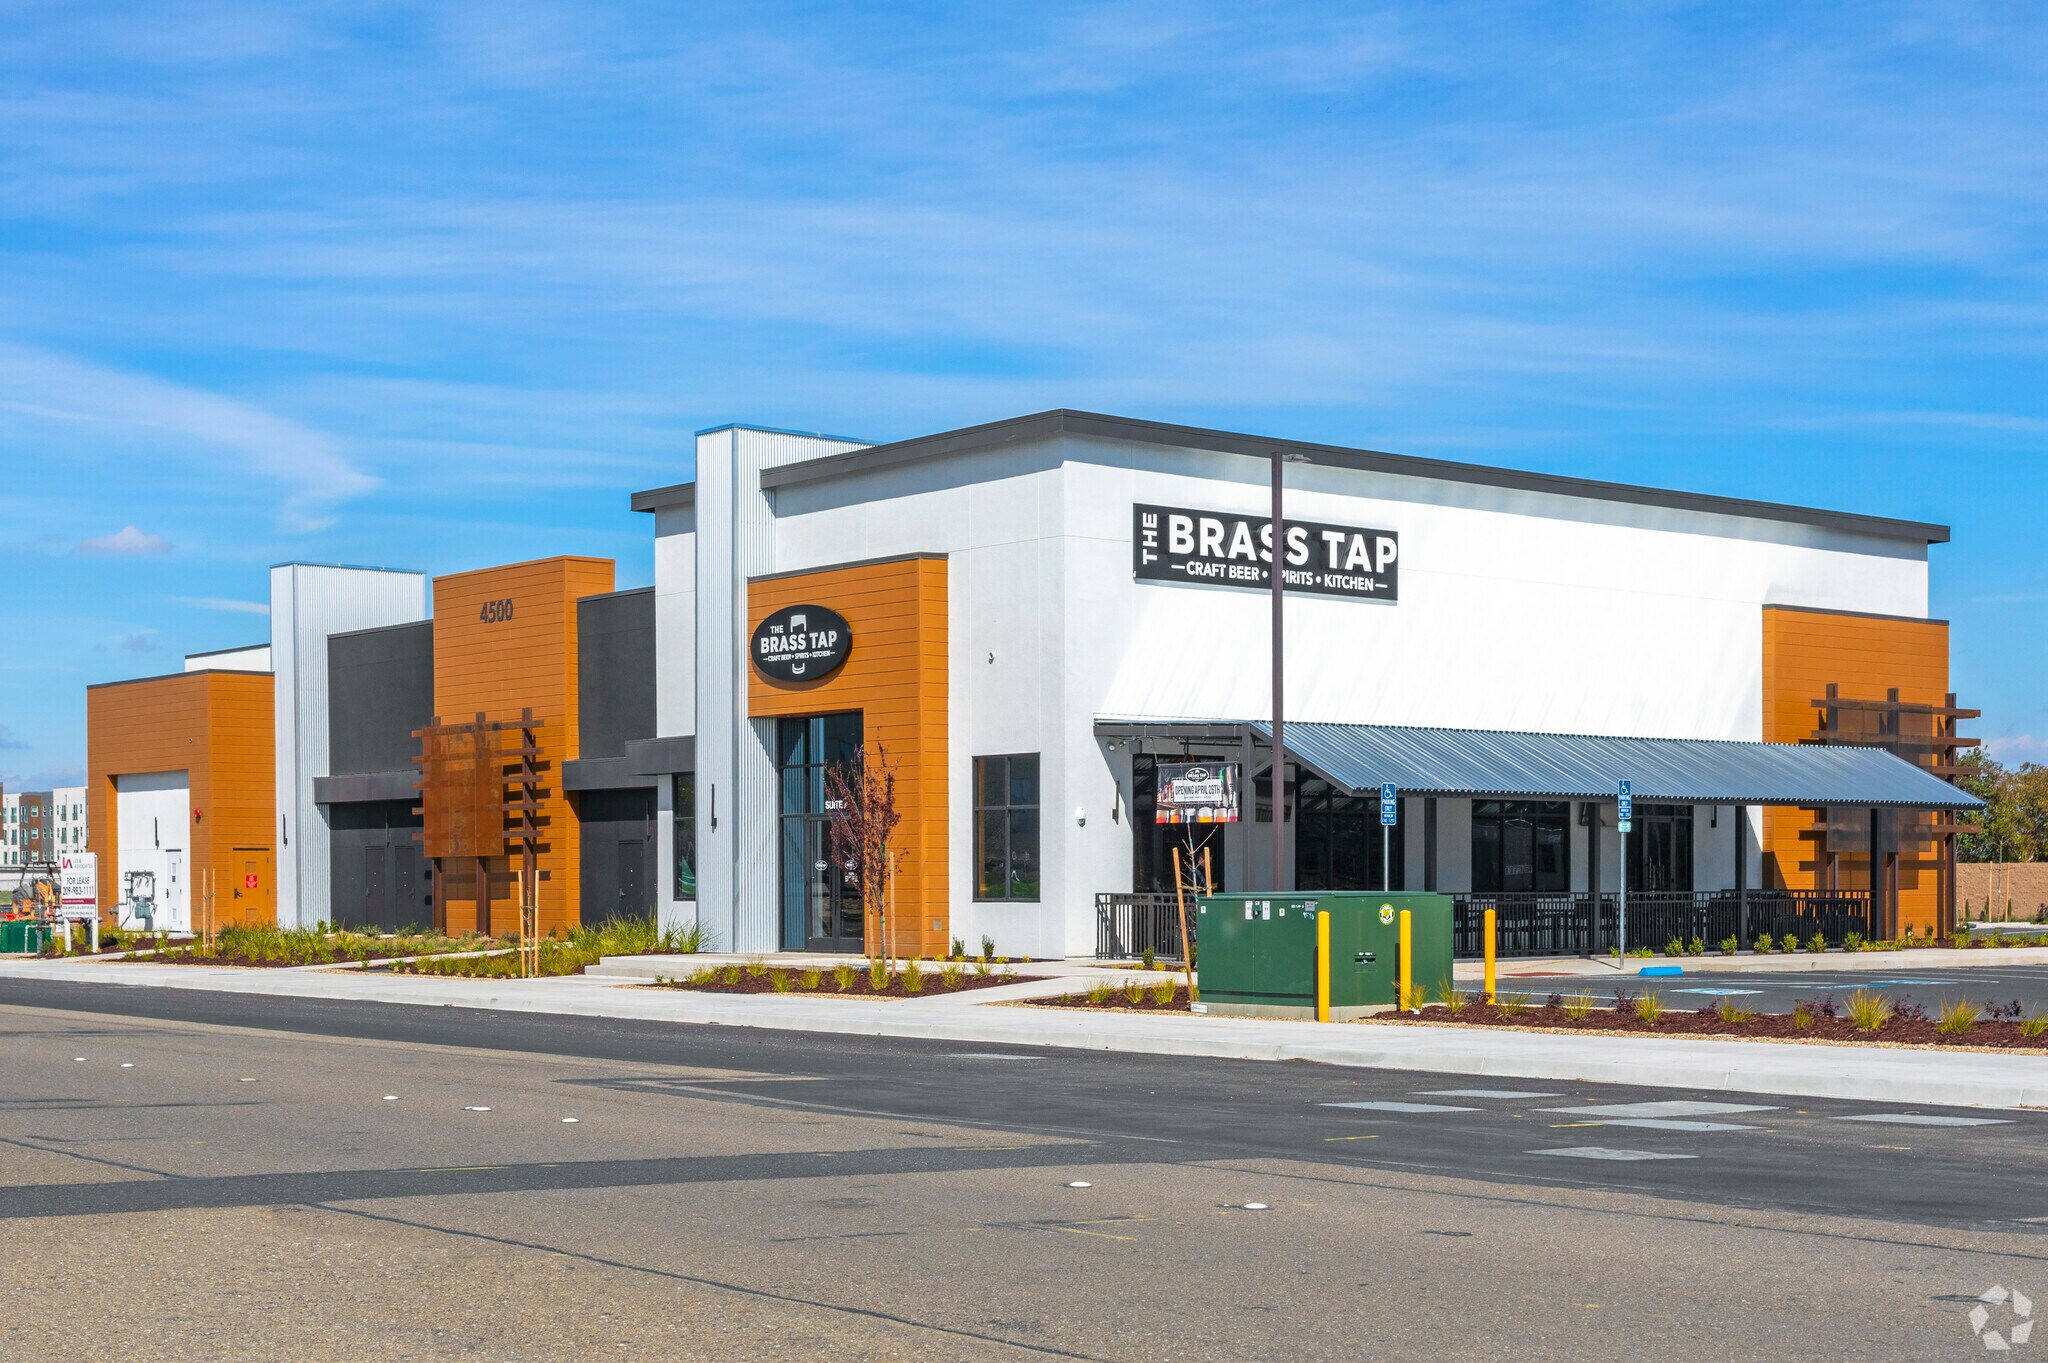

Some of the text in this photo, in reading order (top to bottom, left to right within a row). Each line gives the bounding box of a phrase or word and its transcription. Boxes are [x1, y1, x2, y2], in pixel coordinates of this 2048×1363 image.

[1142, 512, 1158, 565] THE
[1168, 514, 1397, 573] BRASS TAP
[1186, 561, 1374, 591] CRAFT BEER PIRITS KITCHEN
[480, 598, 513, 624] 4500
[770, 625, 784, 634] THE
[760, 630, 837, 654] BRASS TAP
[1175, 785, 1194, 795] OPENING
[1195, 785, 1208, 795] APRIL
[825, 800, 843, 809] SUITE
[67, 877, 90, 885] FOR LEASE
